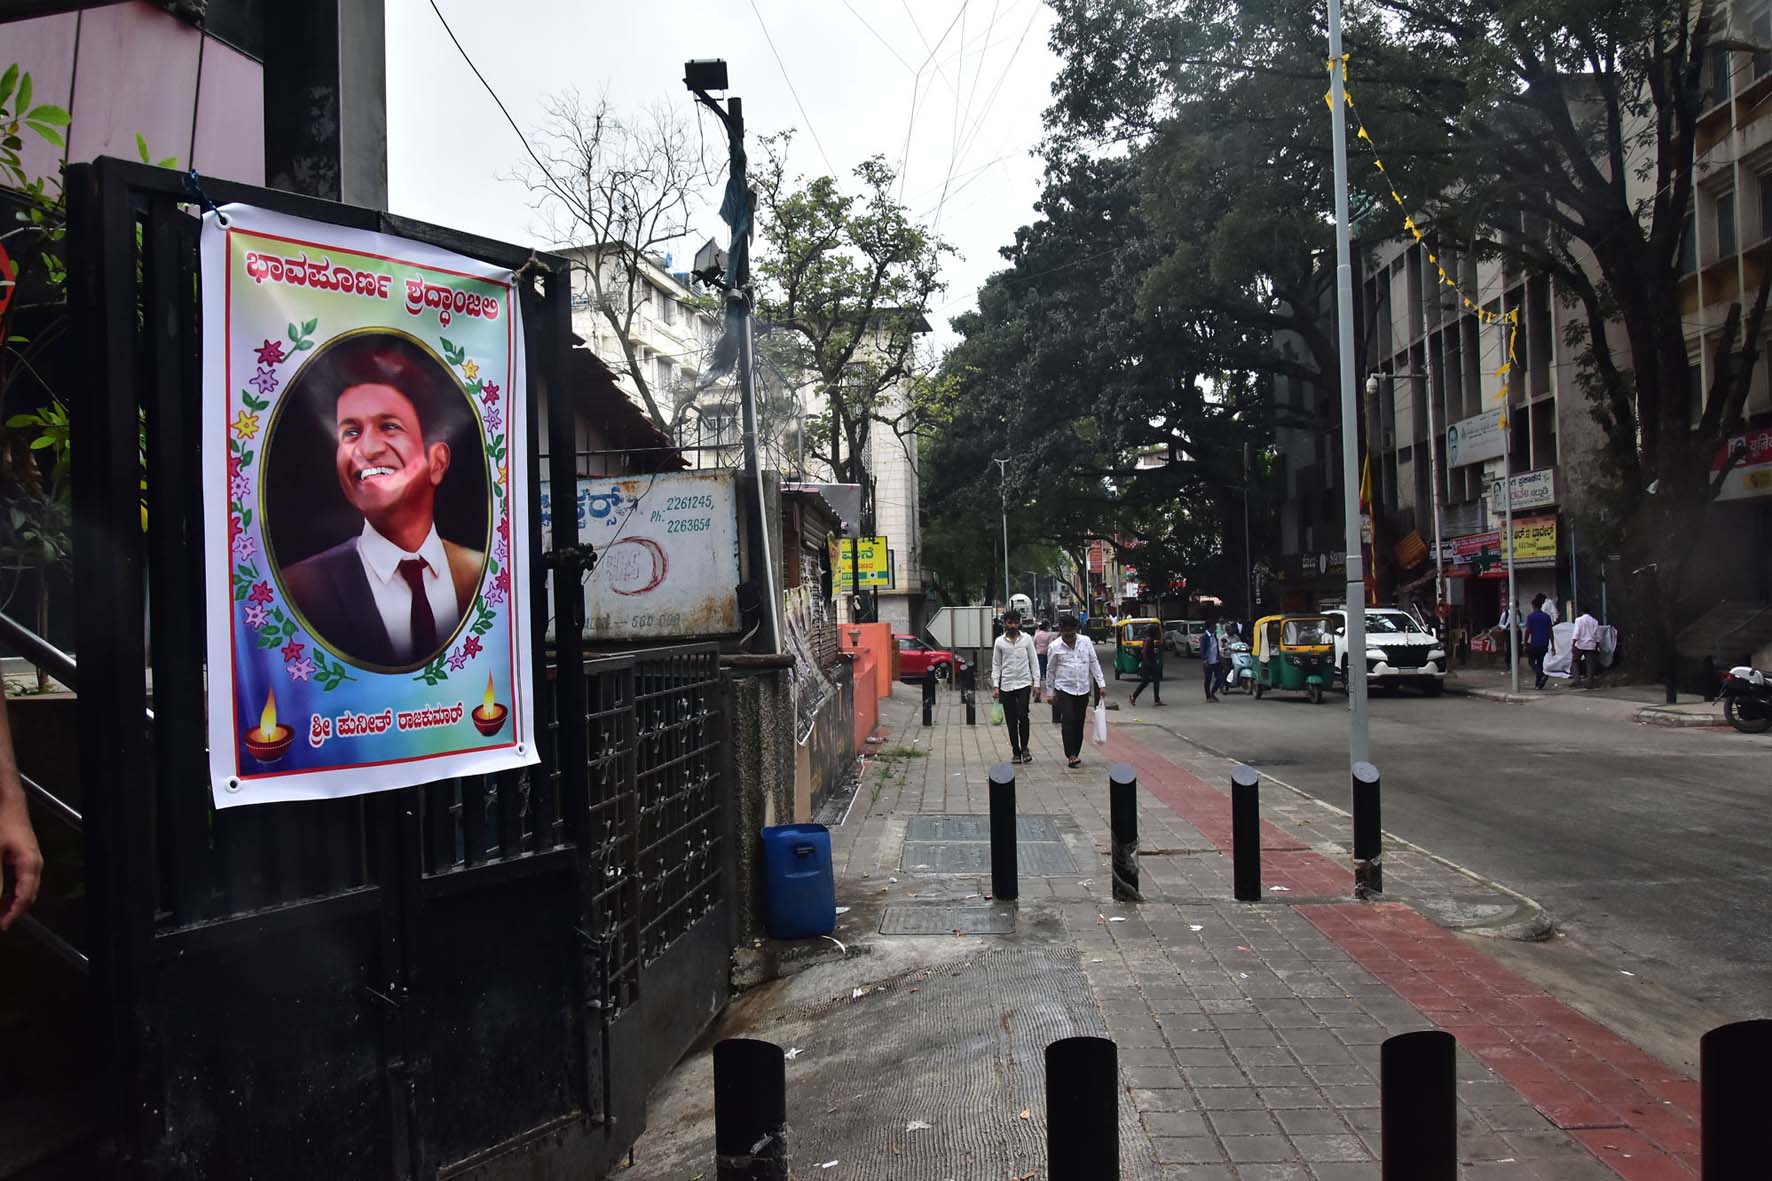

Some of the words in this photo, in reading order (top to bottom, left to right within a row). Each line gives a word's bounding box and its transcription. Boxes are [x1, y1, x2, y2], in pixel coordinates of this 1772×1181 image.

[246, 252, 392, 298] ಭಾವಪೂರ್ಣ
[405, 279, 499, 326] ಶ್ರದ್ಧಾಂಜಲಿ
[667, 495, 714, 511] 2261245,
[650, 509, 666, 523] Ph:
[667, 518, 711, 533] 2263654
[310, 712, 331, 746] ಶ್ರೀ
[337, 710, 392, 737] ಪುನೀತ್
[398, 702, 464, 730] ರಾಜಕುಮಾರ್
